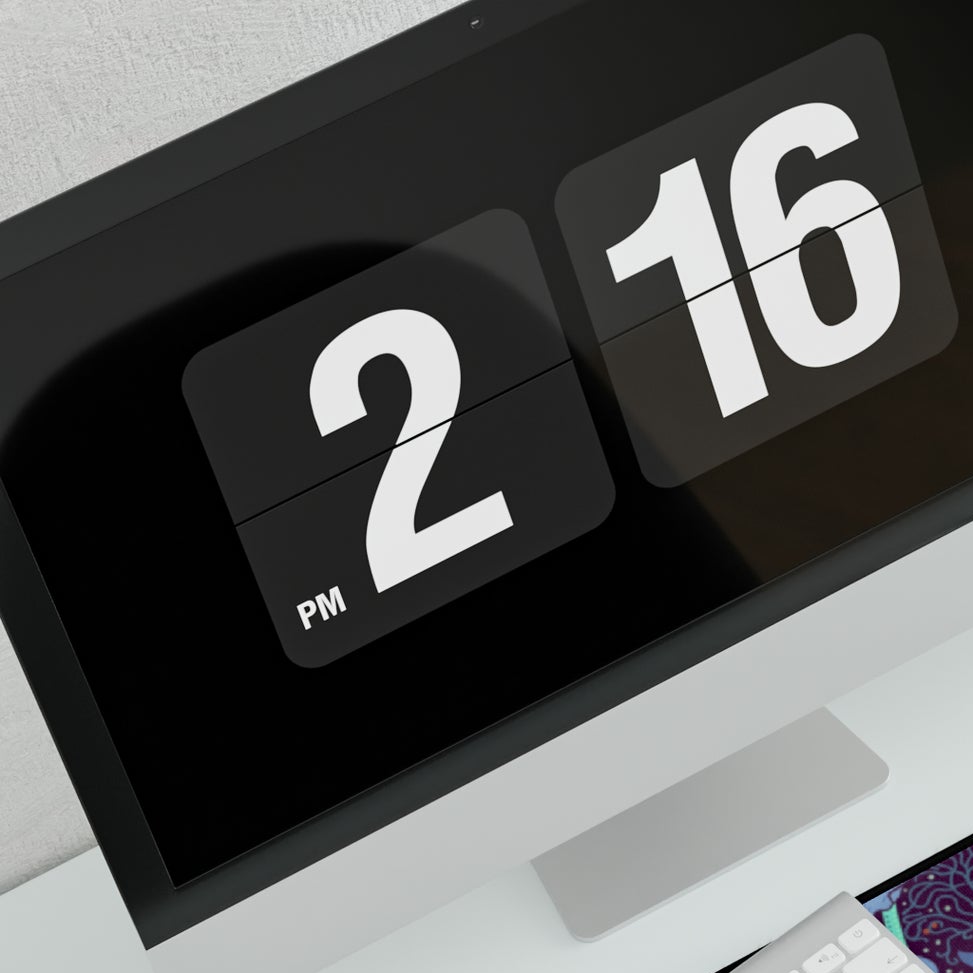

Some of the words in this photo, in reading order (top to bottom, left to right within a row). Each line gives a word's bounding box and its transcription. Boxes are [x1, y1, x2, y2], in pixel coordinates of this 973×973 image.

[309, 309, 514, 594] 2
[606, 102, 901, 418] 16
[297, 586, 347, 630] PM
